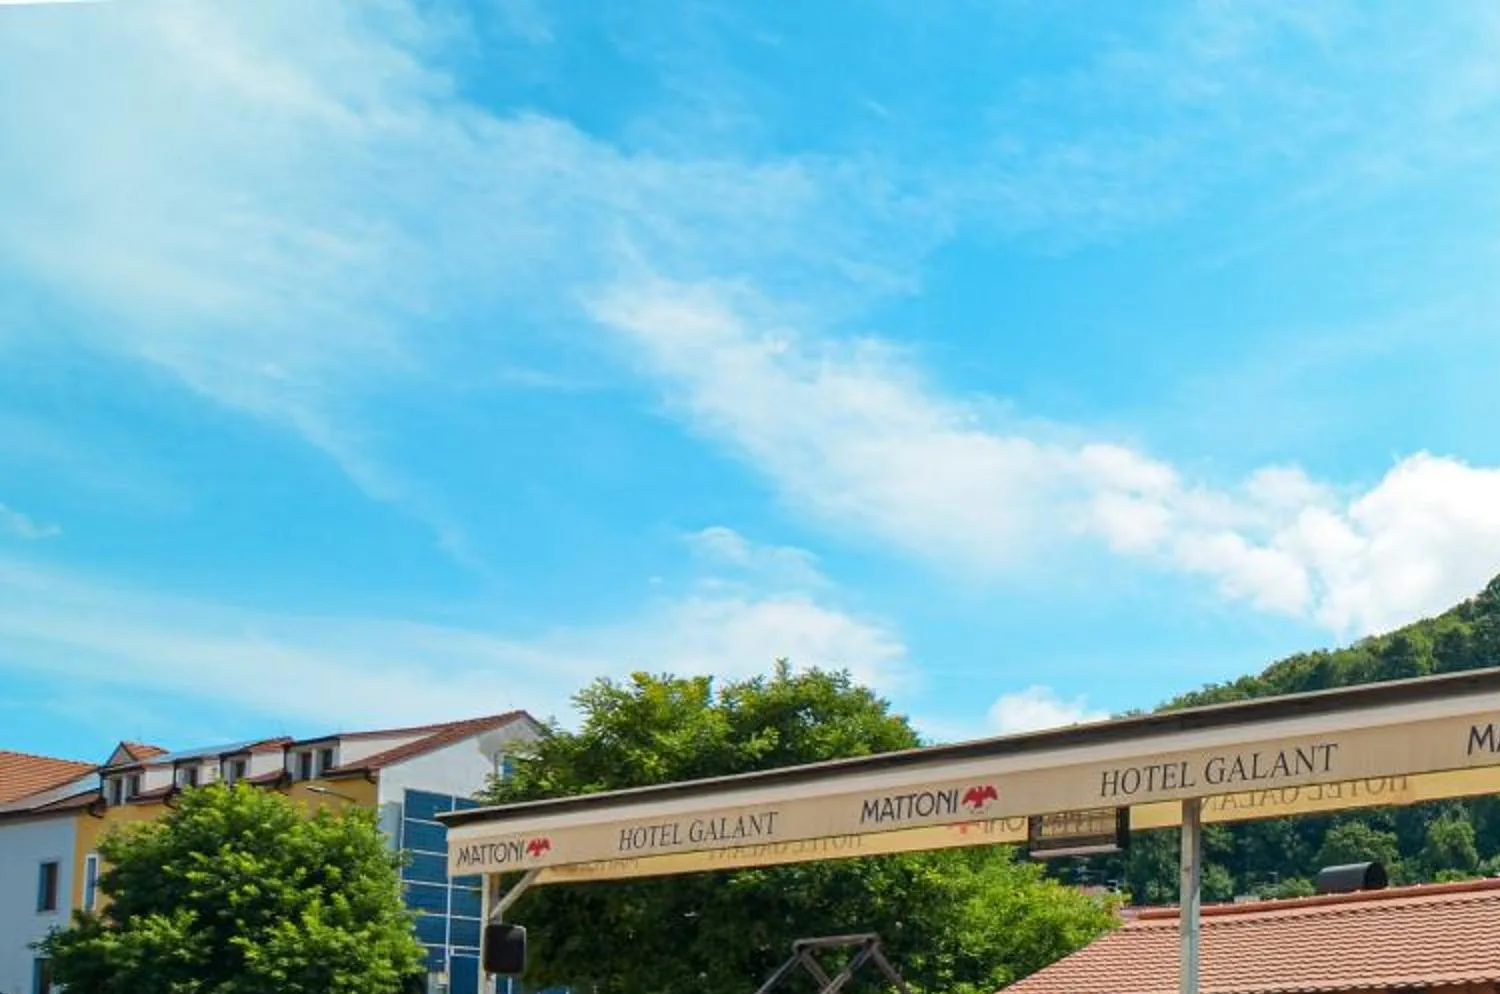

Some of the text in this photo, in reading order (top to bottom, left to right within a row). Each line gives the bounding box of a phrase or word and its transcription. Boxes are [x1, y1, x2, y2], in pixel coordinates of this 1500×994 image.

[1100, 743, 1339, 798] HOTEL GALANT
[861, 788, 959, 824] MATTONI
[618, 822, 683, 851] HOTEL
[689, 811, 779, 843] GALANT
[456, 839, 525, 867] MATTONI
